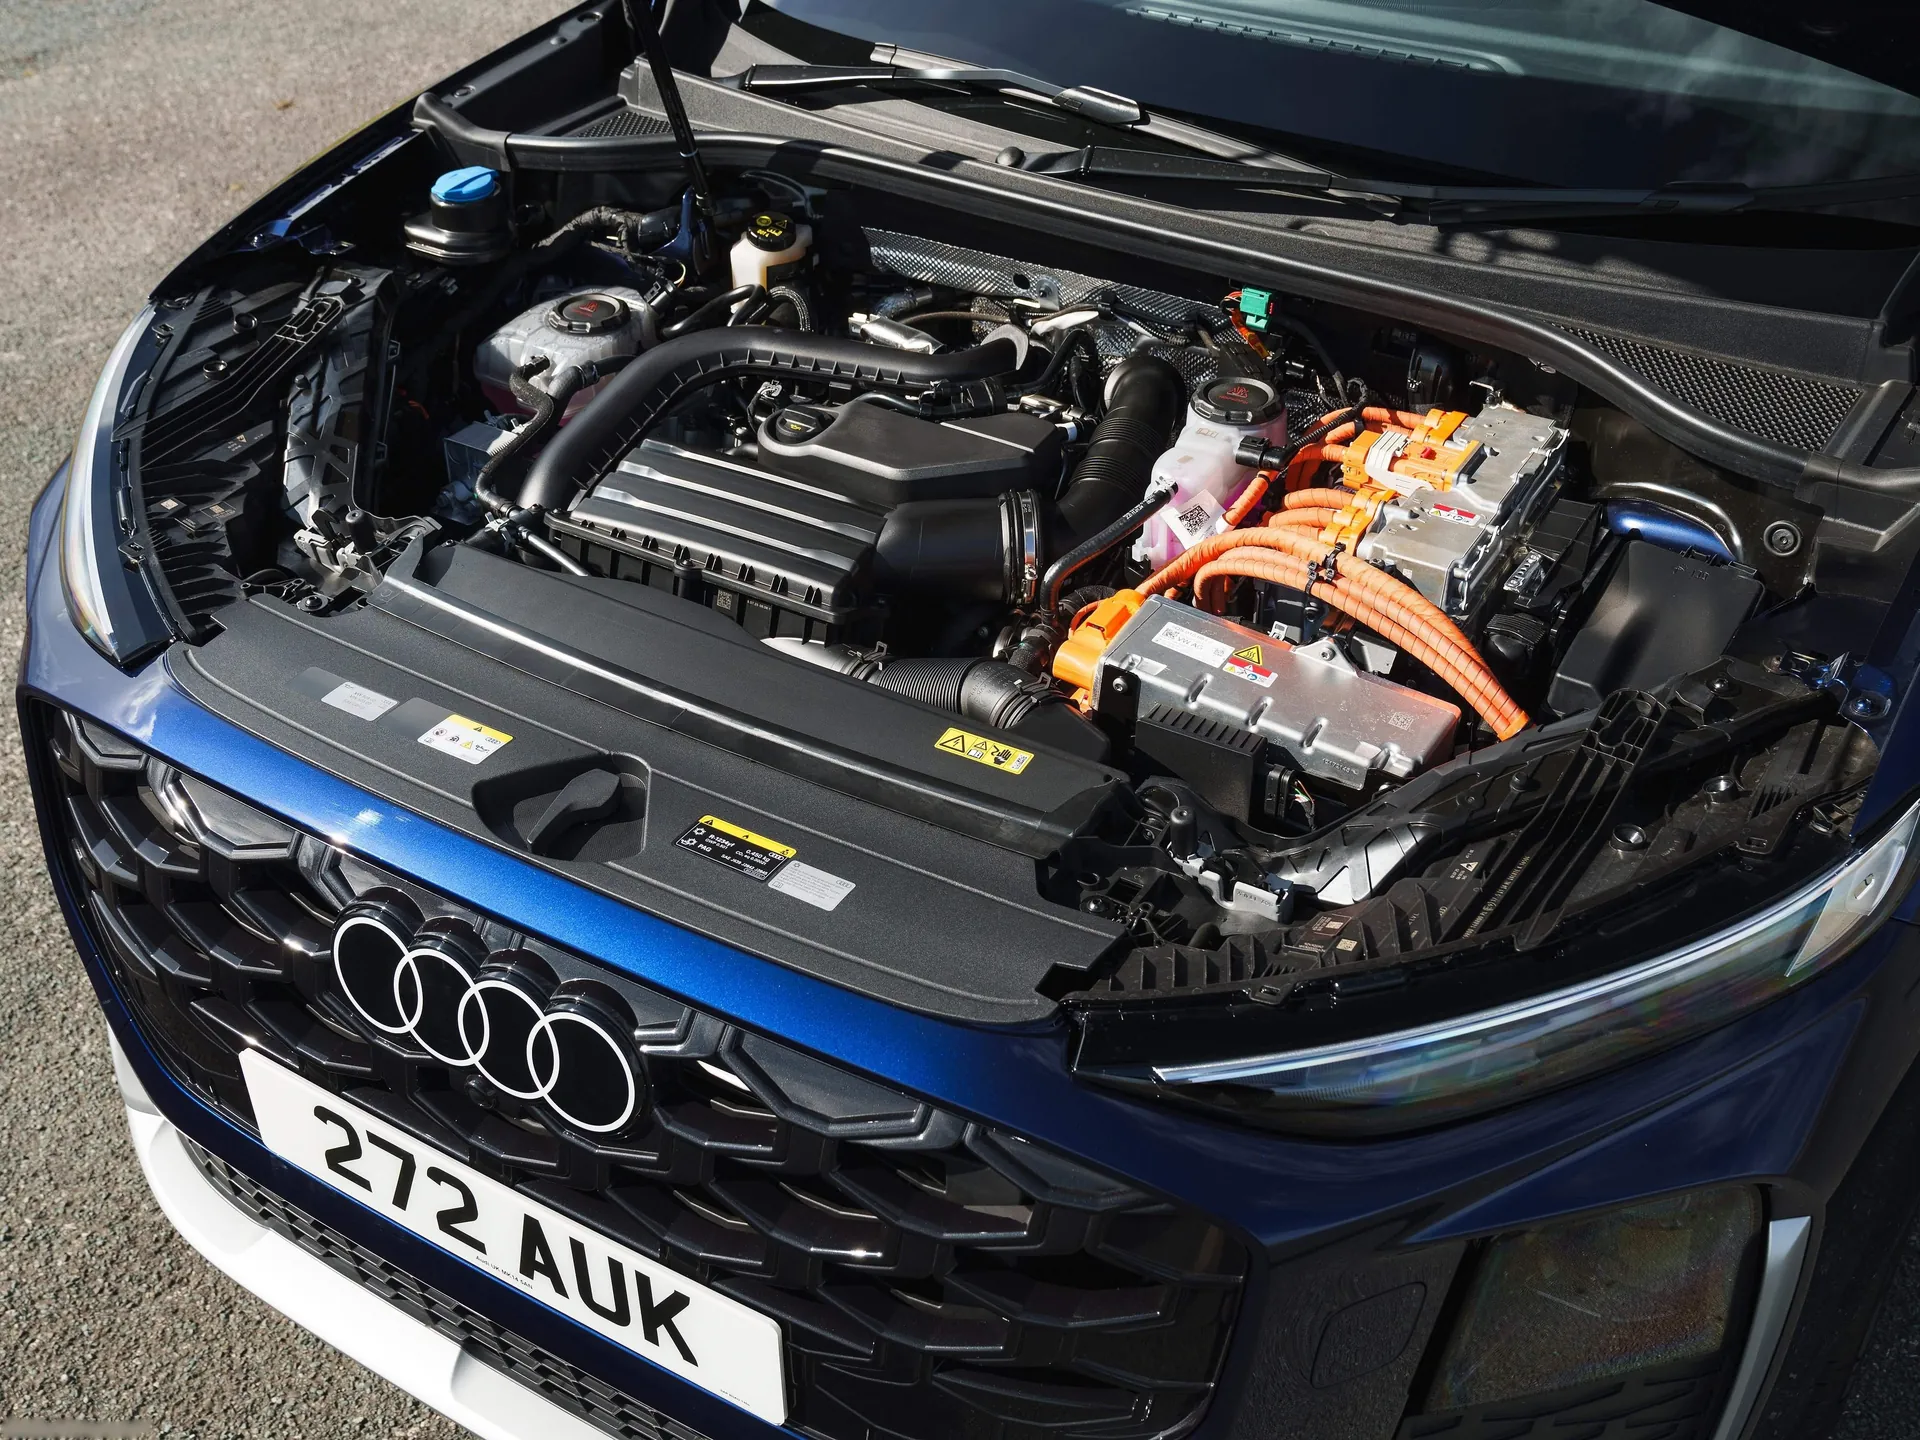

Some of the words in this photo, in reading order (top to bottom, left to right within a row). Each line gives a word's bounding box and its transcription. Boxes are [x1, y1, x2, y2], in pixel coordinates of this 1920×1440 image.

[698, 844, 712, 852] PAG
[708, 834, 735, 848] R-1234yf
[746, 849, 762, 859] 0.450
[762, 855, 771, 863] kg
[314, 1106, 486, 1255] 272
[519, 1213, 698, 1367] AUK
